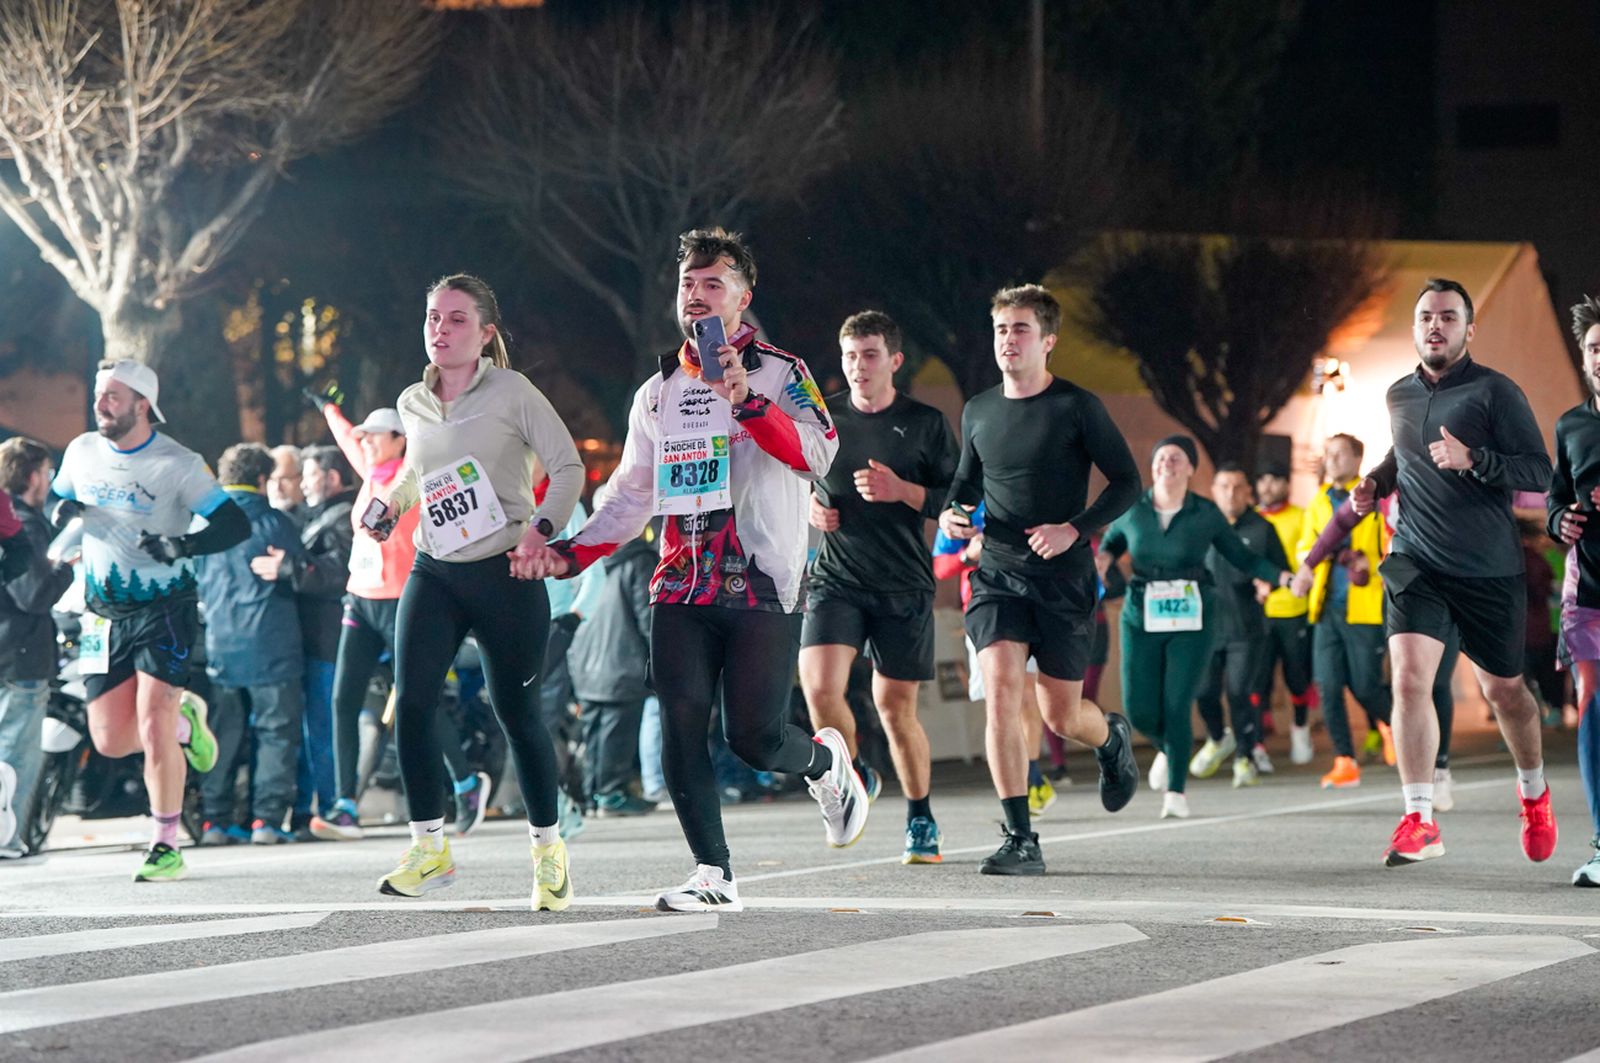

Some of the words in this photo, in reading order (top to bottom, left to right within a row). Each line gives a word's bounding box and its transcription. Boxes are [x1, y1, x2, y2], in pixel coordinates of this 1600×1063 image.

[670, 441, 696, 453] NOCHE
[697, 440, 707, 449] DE
[663, 454, 680, 464] SAN
[670, 459, 720, 488] 8328
[428, 487, 478, 527] 5837
[1158, 598, 1190, 614] 1423
